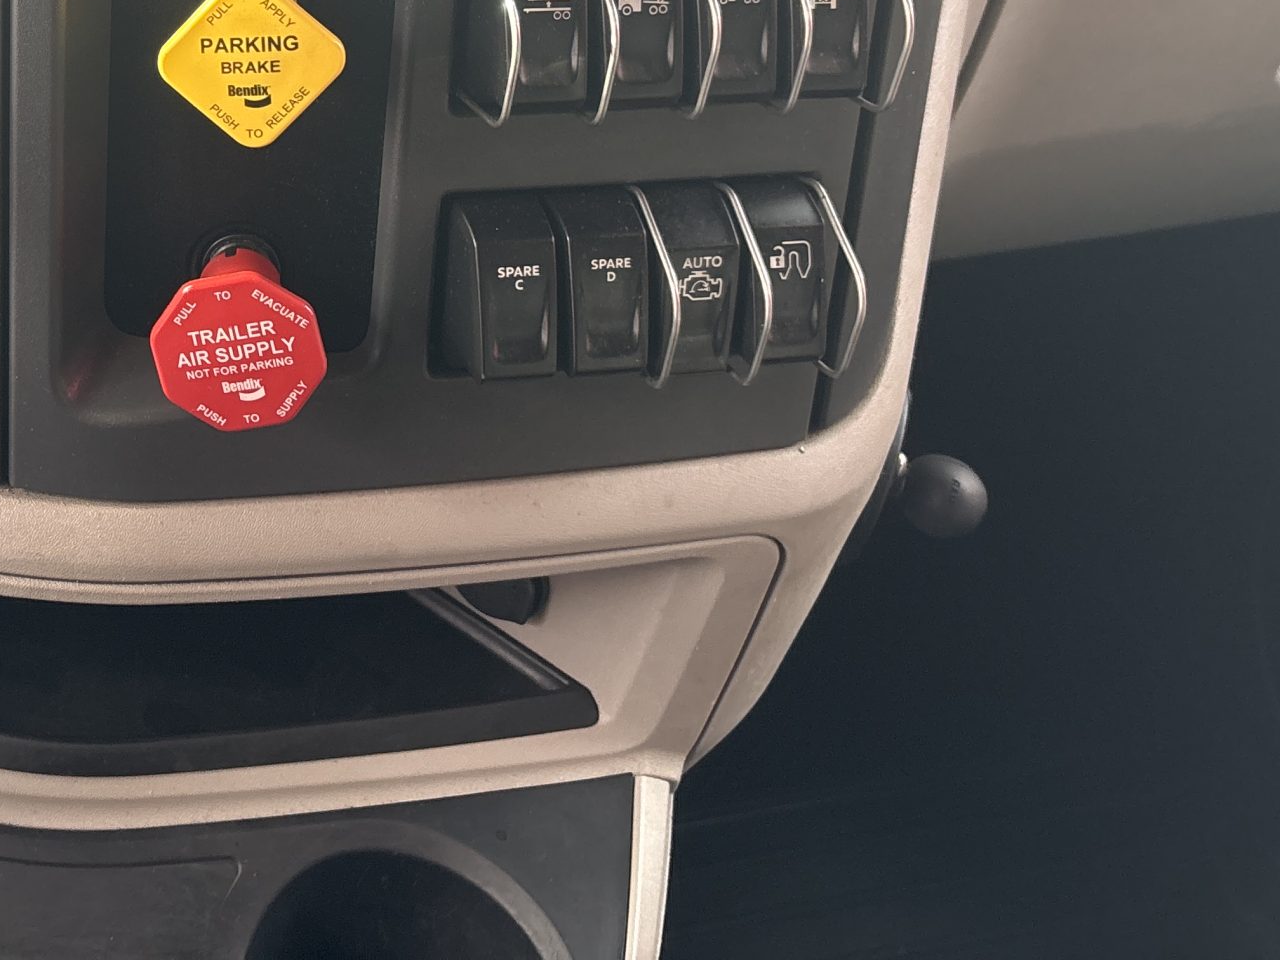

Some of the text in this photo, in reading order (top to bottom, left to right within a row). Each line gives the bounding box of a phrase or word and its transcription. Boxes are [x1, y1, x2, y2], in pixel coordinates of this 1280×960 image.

[206, 1, 234, 26] PULL
[259, 0, 296, 28] APPLY
[200, 35, 299, 54] PARKING
[220, 60, 281, 75] BRAKE
[228, 85, 269, 97] Bendix
[209, 86, 311, 139] PUSH TO RELEASE
[591, 258, 632, 270] SPARE
[682, 255, 723, 269] AUTO
[497, 265, 540, 279] SPARE
[606, 271, 616, 282] D
[514, 279, 524, 290] C
[173, 289, 309, 329] PULL TO EVACUATE
[187, 320, 276, 347] TRAILER
[177, 336, 295, 369] AIR SUPPLY
[186, 356, 293, 380] NOT FOR PARKING
[221, 378, 261, 394] Bendix
[196, 380, 308, 426] PUSH TO SUPPLY
